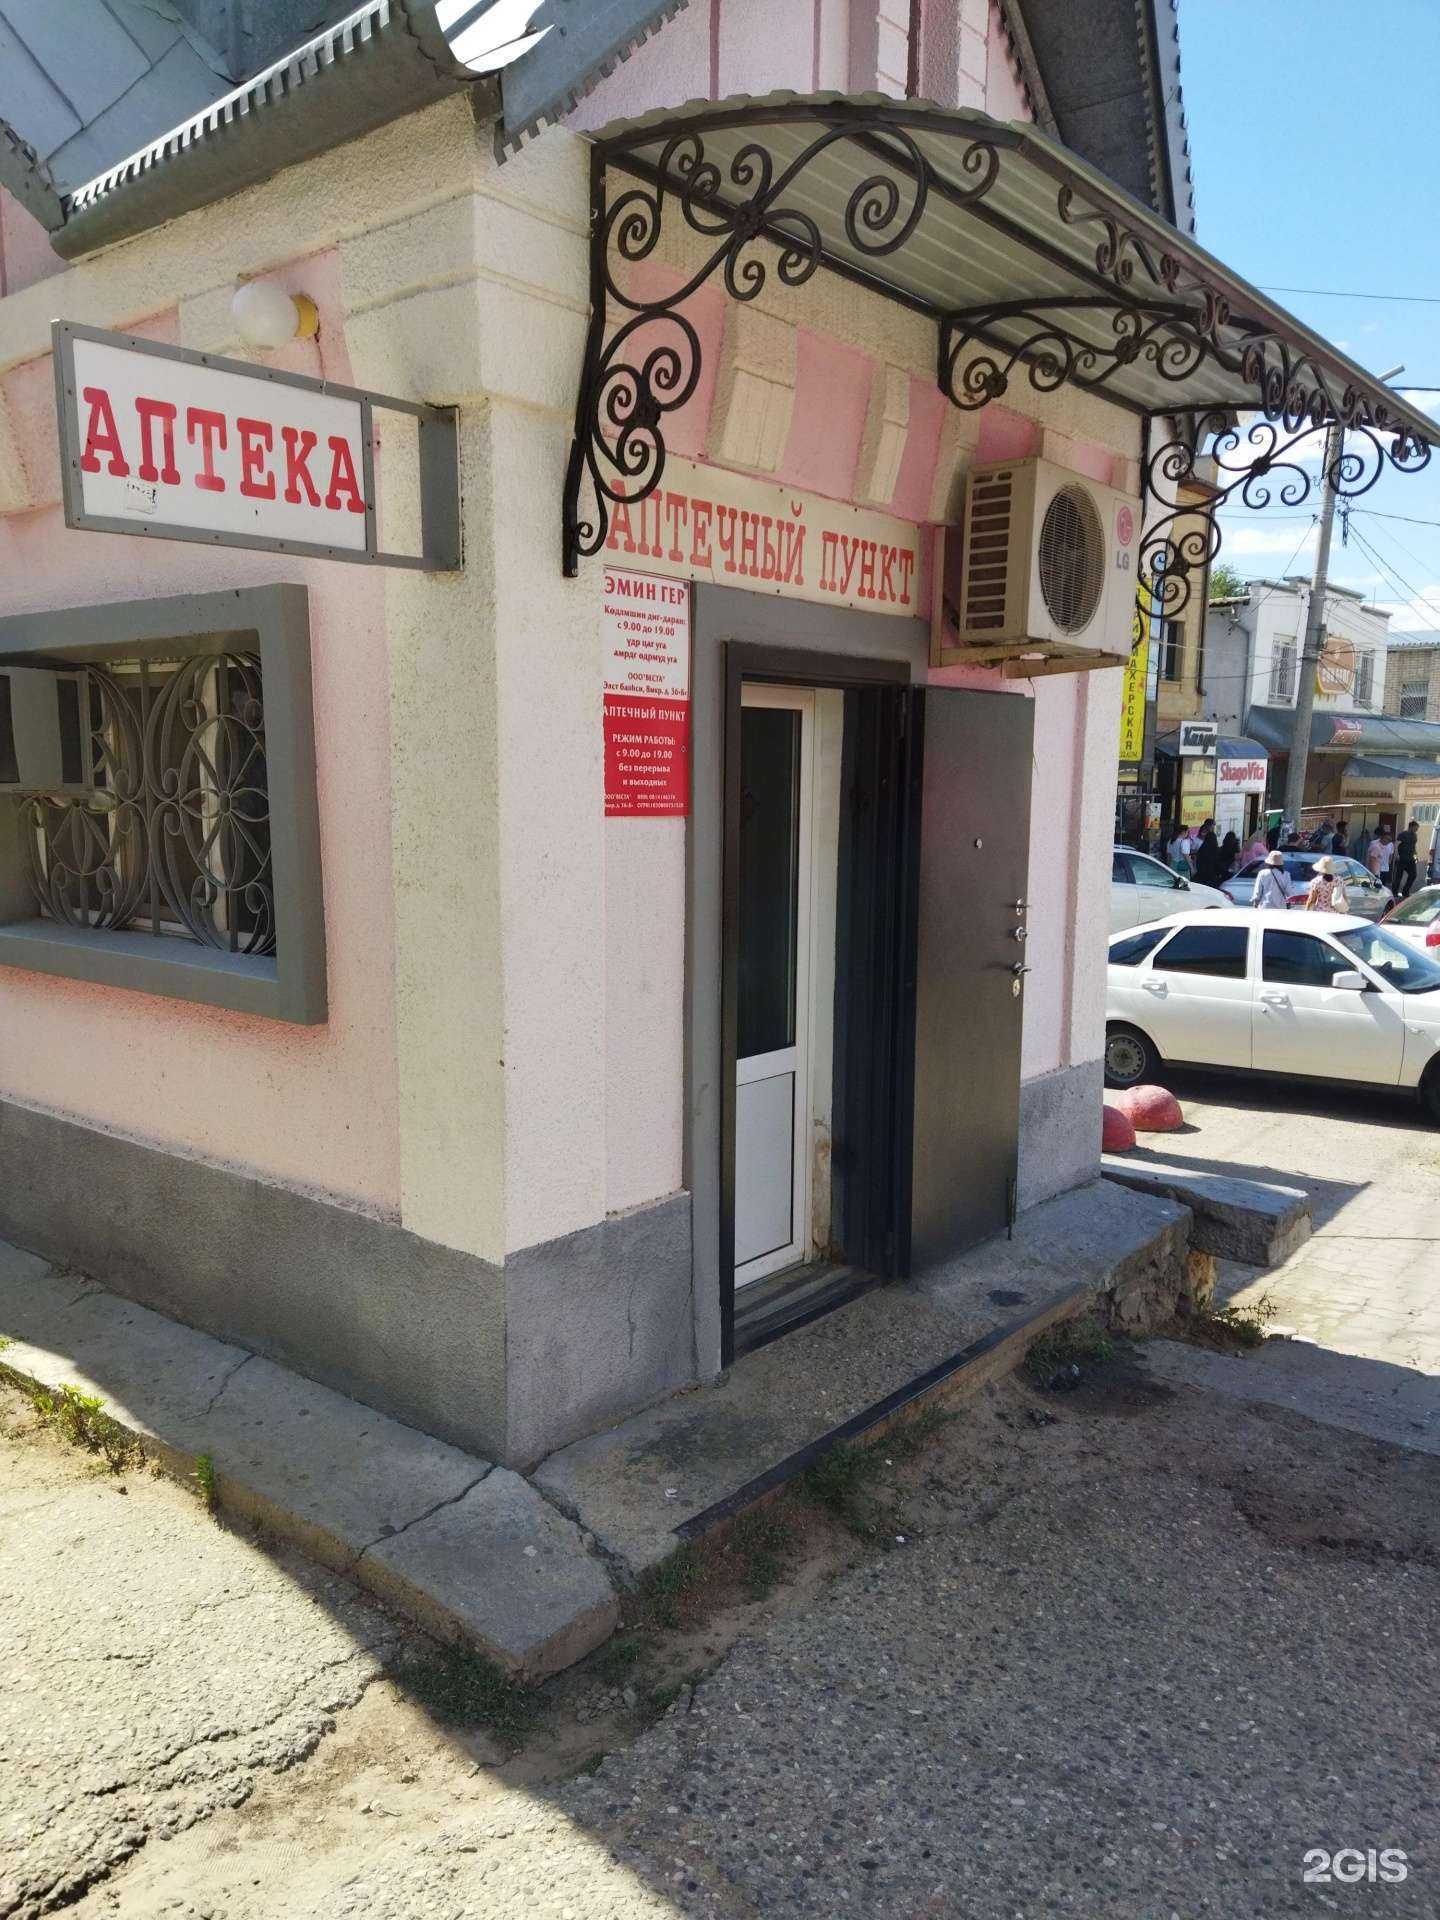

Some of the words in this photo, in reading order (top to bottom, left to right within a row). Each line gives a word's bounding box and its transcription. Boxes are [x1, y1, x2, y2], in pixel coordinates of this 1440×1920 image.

[81, 386, 366, 514] АПТЕКА
[605, 479, 806, 586] АПТЕЧНЫЙ
[819, 530, 914, 604] ПУНКТ
[1116, 550, 1129, 571] LG
[604, 576, 656, 600] ЭМИН
[661, 585, 685, 605] ГЕР
[623, 621, 641, 631] 9.00
[642, 625, 652, 634] до
[655, 626, 675, 636] 19.00
[603, 705, 656, 719] АПТЕЧНЫЙ
[658, 709, 686, 721] ПУНКТ
[612, 733, 642, 744] РЕЖИМ
[622, 748, 640, 758] 9.00
[640, 751, 651, 759] до
[653, 750, 673, 759] 19.00
[618, 763, 632, 772] без
[633, 765, 671, 774] перерыва
[629, 779, 667, 787] выходных
